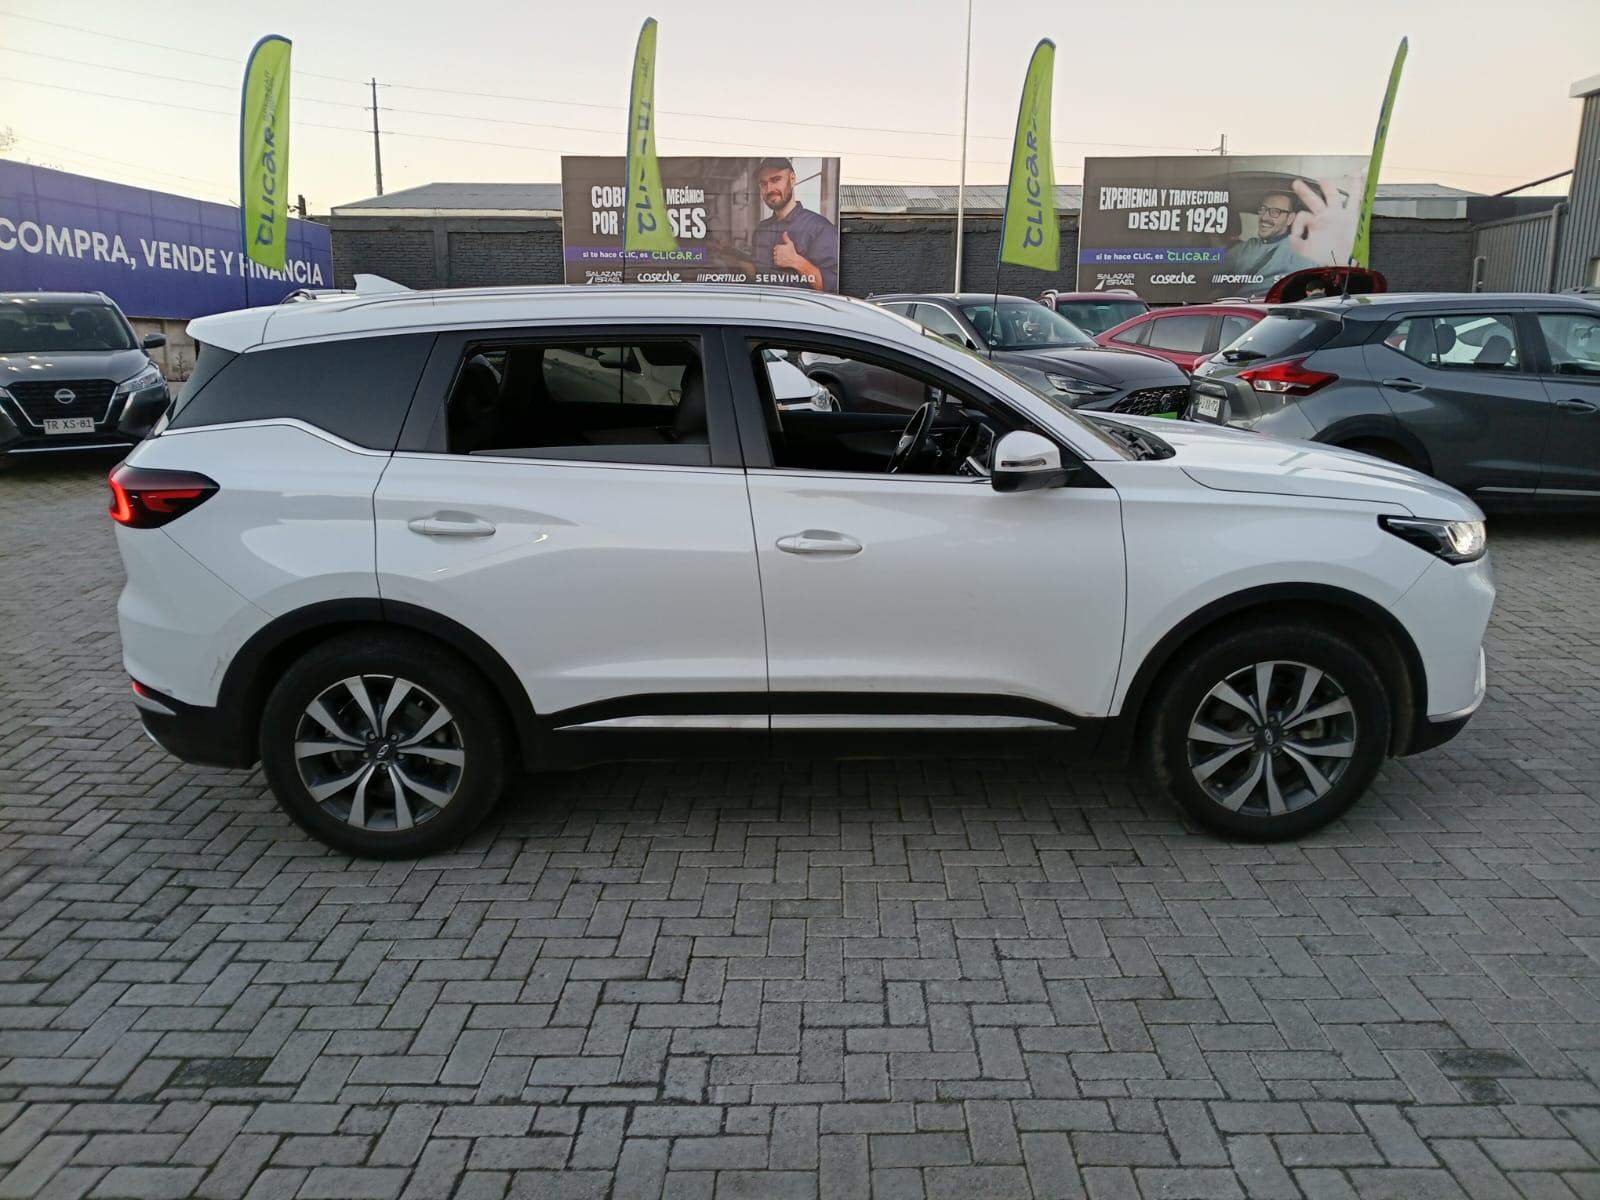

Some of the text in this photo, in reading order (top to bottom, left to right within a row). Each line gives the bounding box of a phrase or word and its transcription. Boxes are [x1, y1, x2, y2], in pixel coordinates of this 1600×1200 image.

[666, 185, 705, 205] MECÁNICA
[1099, 187, 1229, 210] EXPERIENCIA Y TRAYECTORIA
[592, 210, 619, 235] POR
[666, 208, 707, 239] SES
[1128, 205, 1228, 234] DESDE 1929
[0, 217, 136, 270] COMPRA,
[140, 238, 217, 274] VENDE
[220, 250, 233, 276] Y
[756, 274, 816, 283] SERVIMAQ
